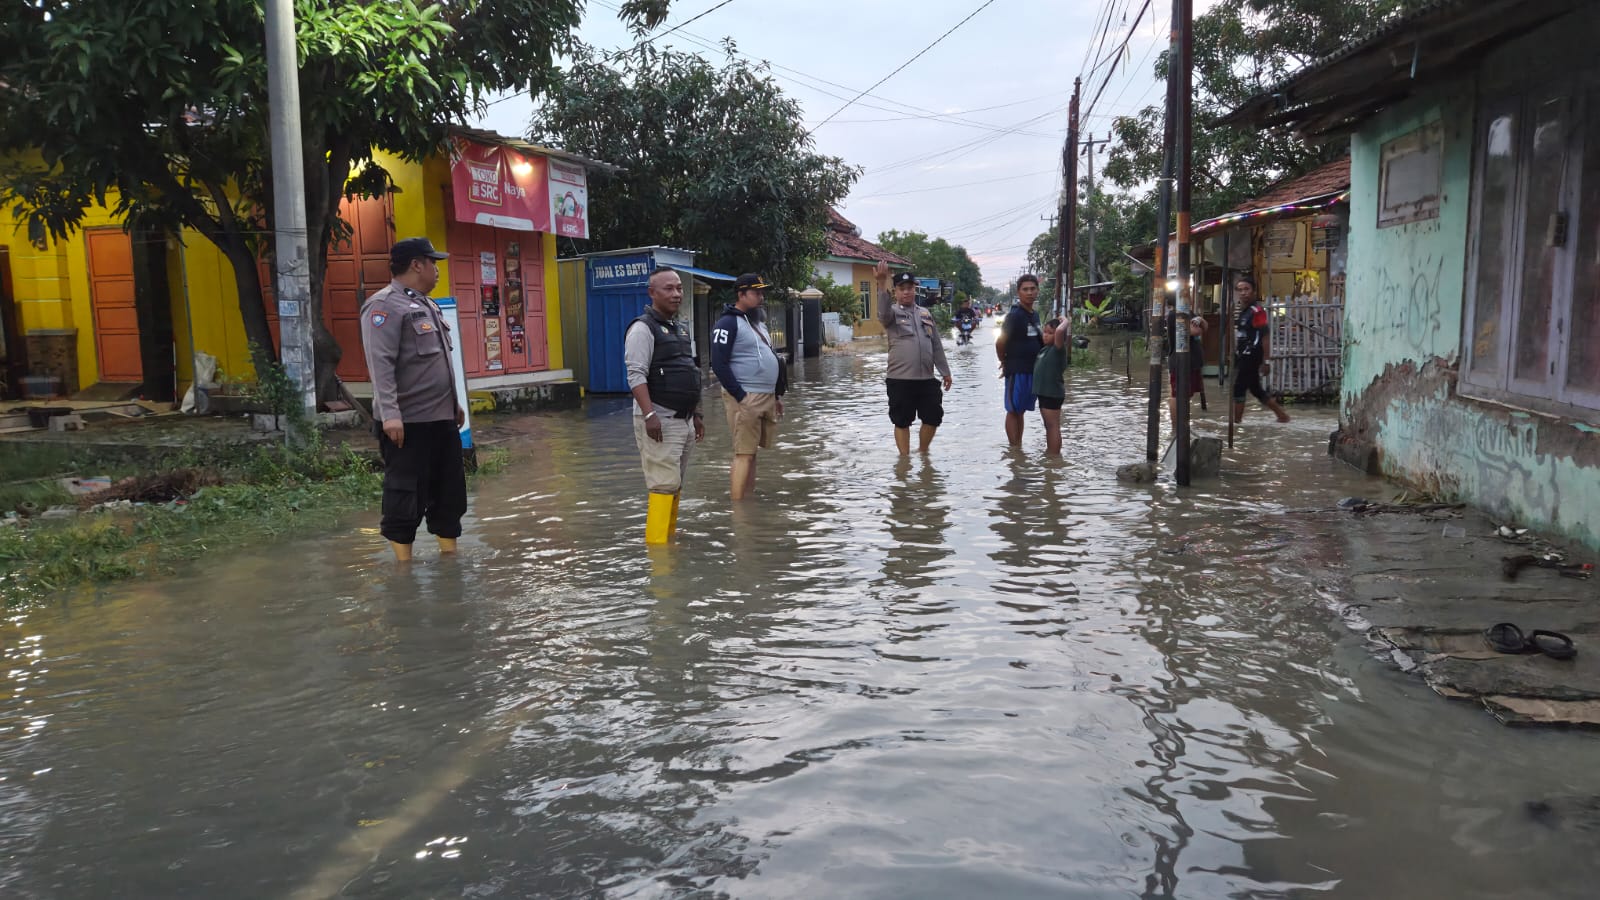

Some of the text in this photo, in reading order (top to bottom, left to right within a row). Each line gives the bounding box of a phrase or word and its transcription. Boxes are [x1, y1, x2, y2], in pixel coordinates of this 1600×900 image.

[473, 168, 497, 183] TOKO
[480, 184, 498, 201] SRC
[504, 181, 526, 199] Naya
[594, 262, 647, 279] JUAL ES BATU
[713, 328, 729, 345] 75
